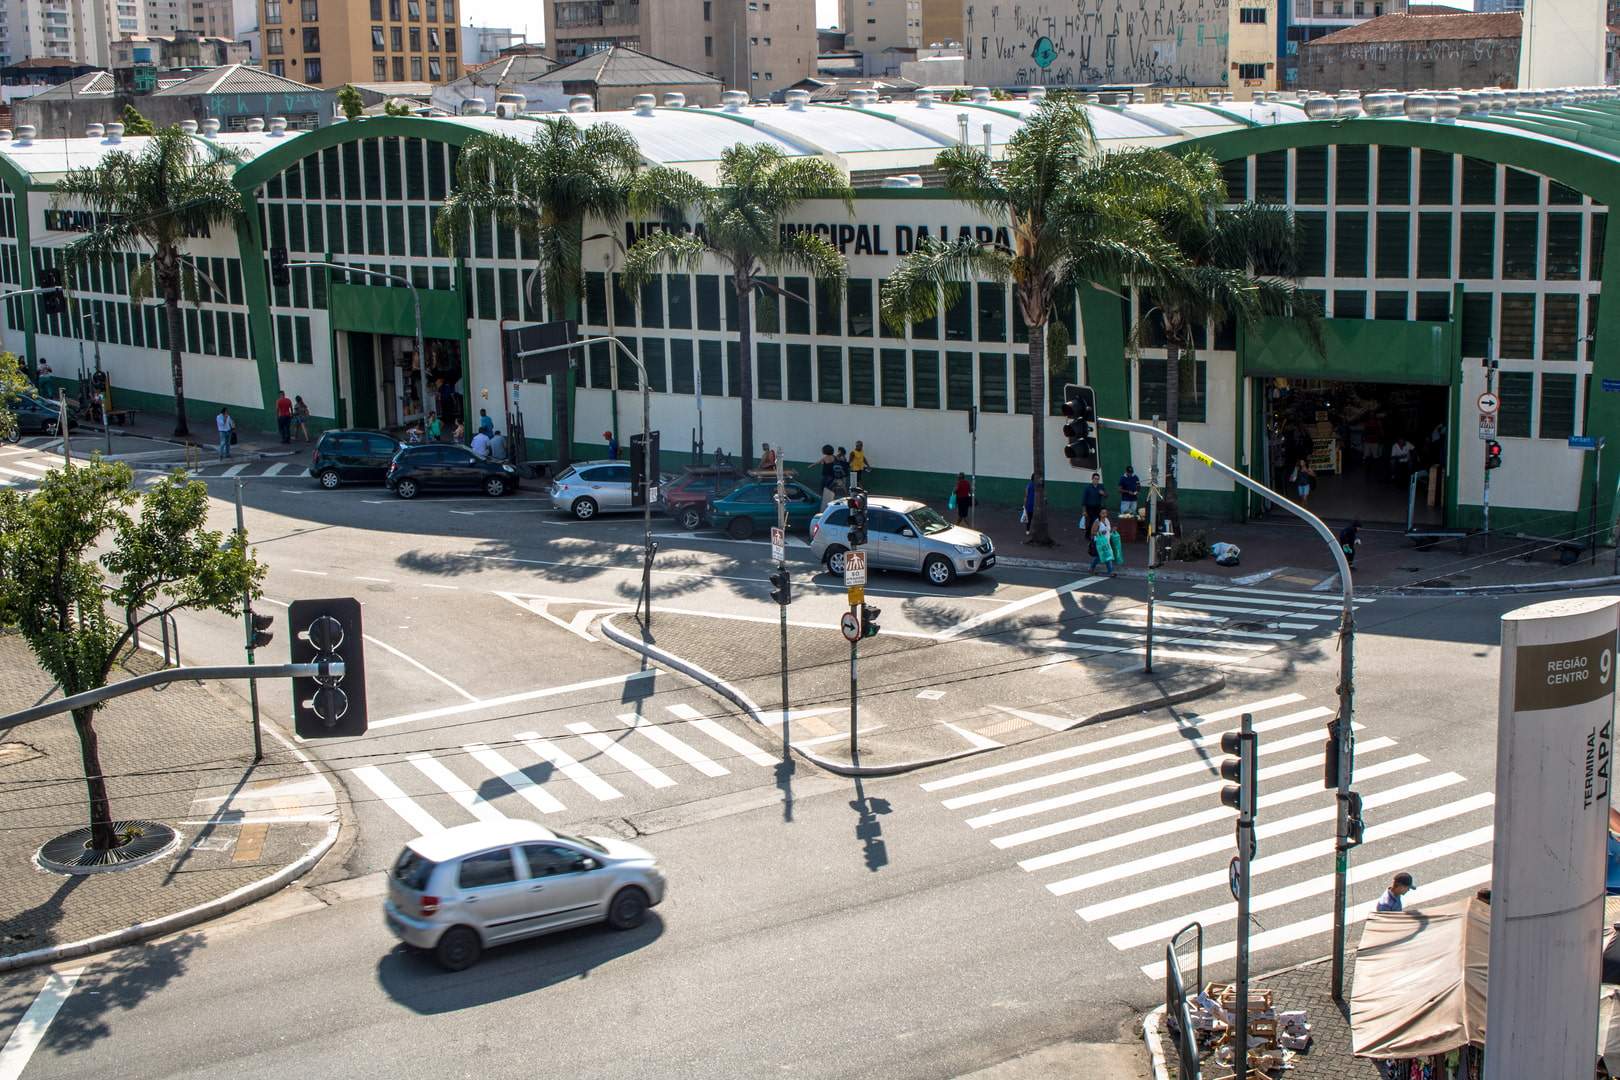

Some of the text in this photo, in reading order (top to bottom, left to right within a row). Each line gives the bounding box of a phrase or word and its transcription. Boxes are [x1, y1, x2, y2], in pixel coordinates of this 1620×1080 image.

[1546, 669, 1589, 685] CENTRO
[1547, 648, 1612, 684] REGIÃO 9
[1583, 726, 1596, 810] TERMINAL
[1596, 719, 1611, 801] LAPA
